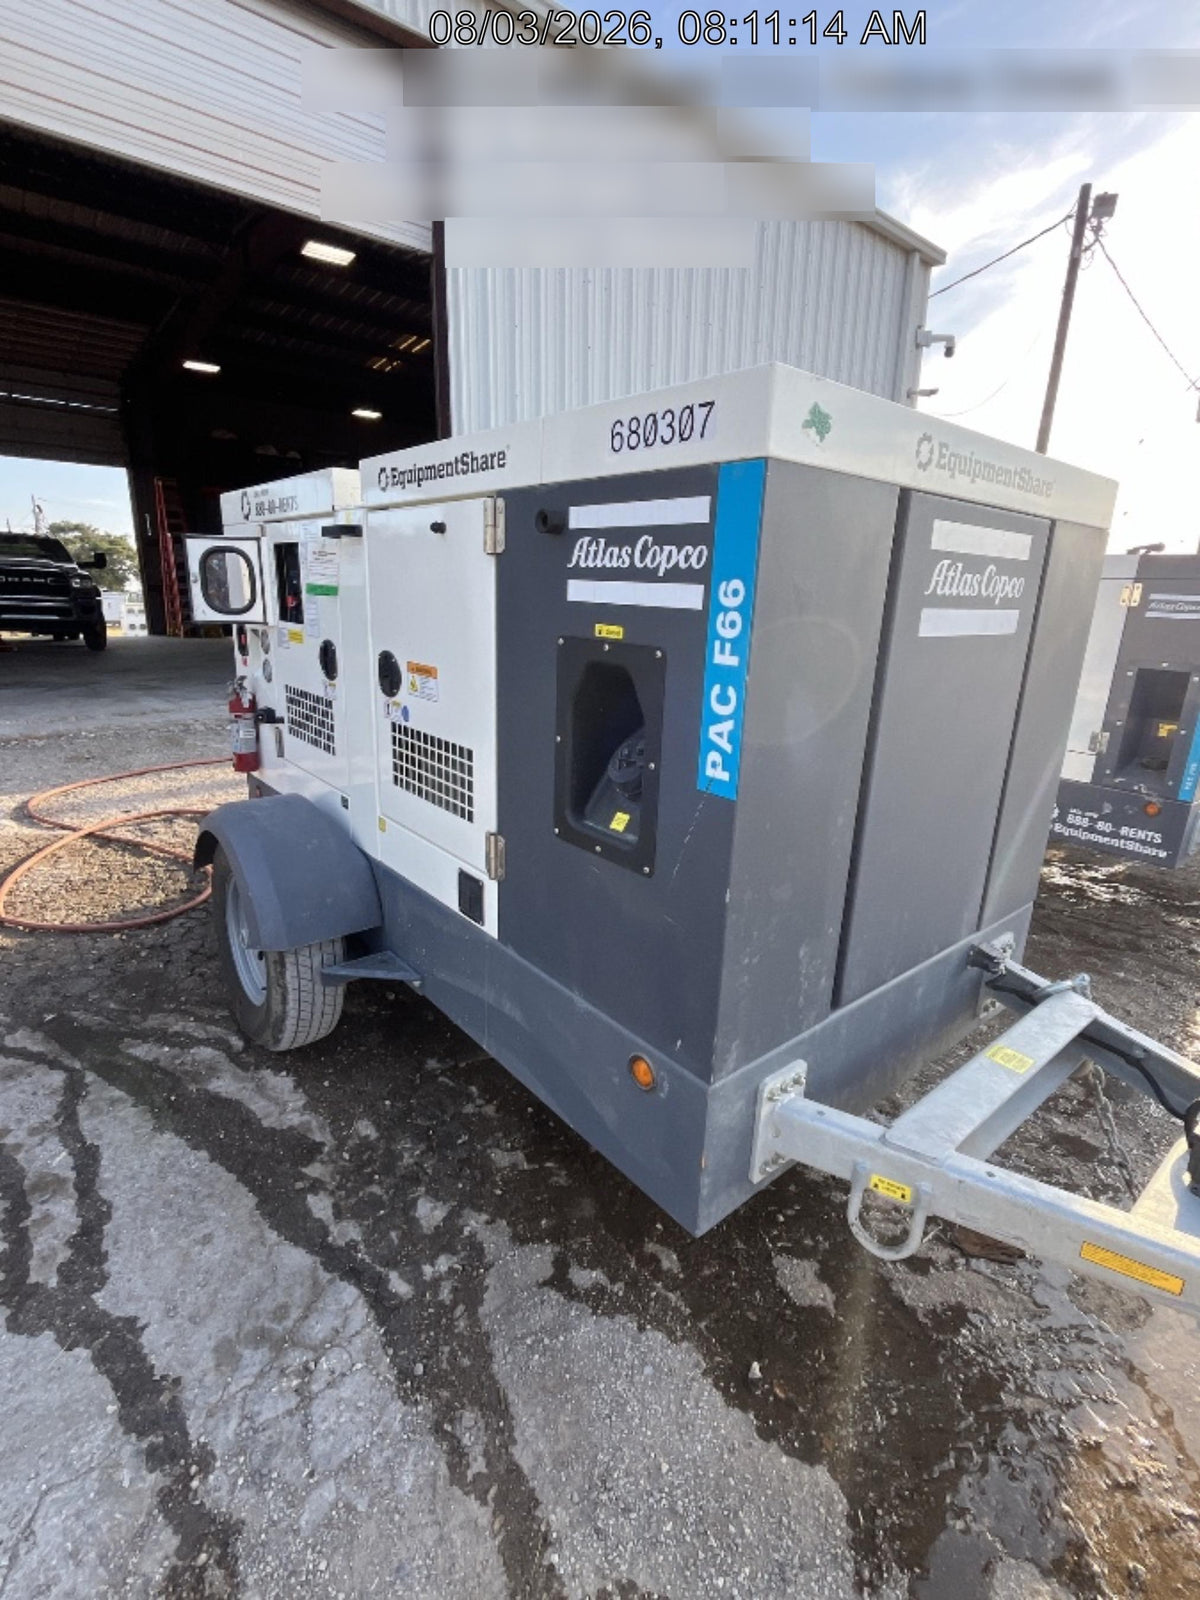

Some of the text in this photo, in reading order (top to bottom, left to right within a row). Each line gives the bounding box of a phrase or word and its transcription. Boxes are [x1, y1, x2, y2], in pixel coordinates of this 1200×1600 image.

[611, 400, 716, 453] 680307
[390, 450, 507, 489] EquipmentShare
[935, 441, 1054, 497] EquipmentShare
[567, 534, 708, 577] Atlas Copco
[924, 559, 1025, 605] Atlas Copco
[705, 578, 745, 781] PAC F66
